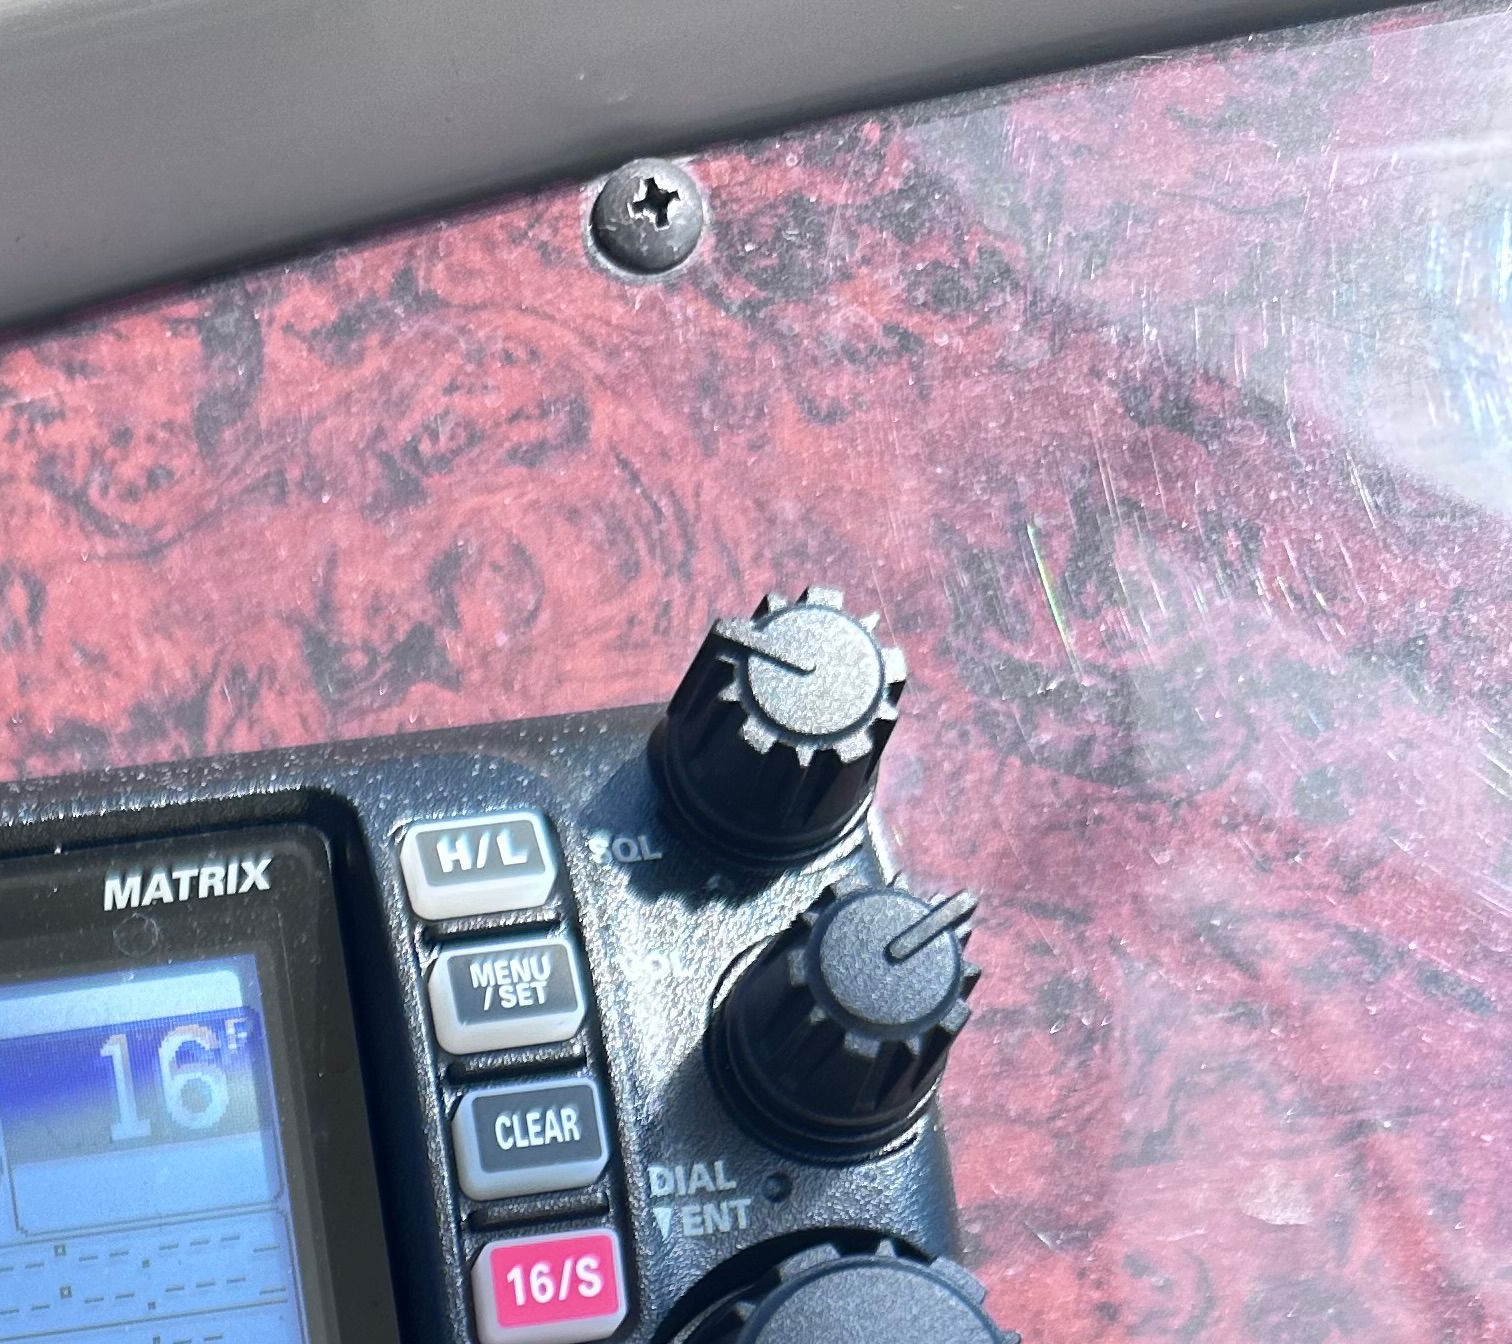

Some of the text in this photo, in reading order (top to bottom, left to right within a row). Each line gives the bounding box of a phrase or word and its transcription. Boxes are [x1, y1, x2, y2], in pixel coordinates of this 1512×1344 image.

[437, 829, 528, 873] H/L
[103, 857, 273, 911] MATRIX
[470, 953, 552, 988] MENU
[100, 1023, 230, 1141] 16
[494, 1106, 581, 1150] CLEAR
[647, 1160, 737, 1198] DIAL
[681, 1198, 752, 1236] ENT
[506, 1254, 604, 1306] 16/S
